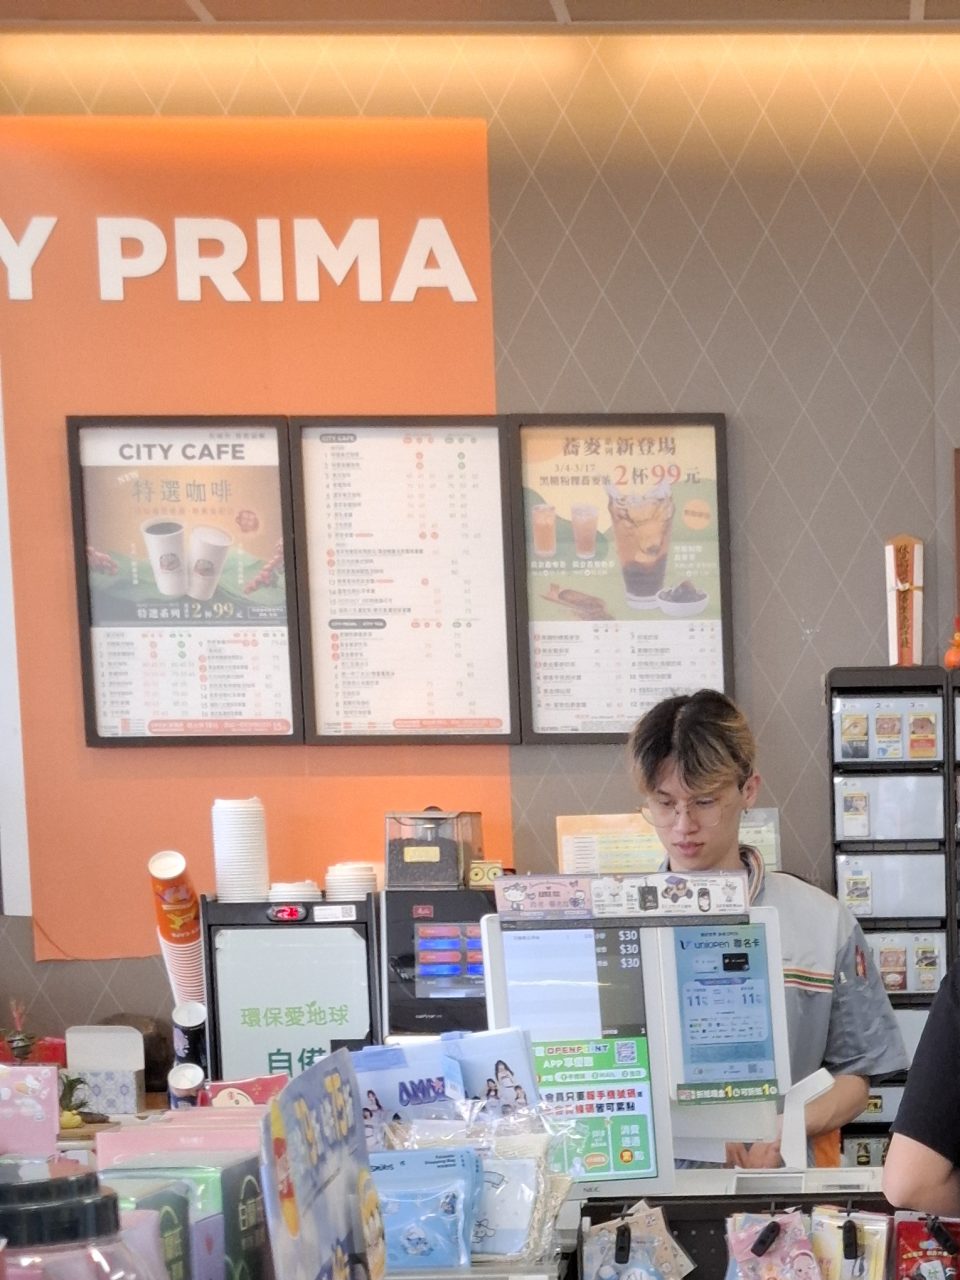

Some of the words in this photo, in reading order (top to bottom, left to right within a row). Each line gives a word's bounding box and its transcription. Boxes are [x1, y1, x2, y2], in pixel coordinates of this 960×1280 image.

[97, 217, 478, 302] PRIMA
[119, 443, 173, 460] CITY
[181, 443, 245, 460] CAFE
[619, 930, 638, 940] $30
[620, 944, 639, 954] $30
[621, 958, 640, 968] $30
[240, 1003, 350, 1028] 環保愛地球
